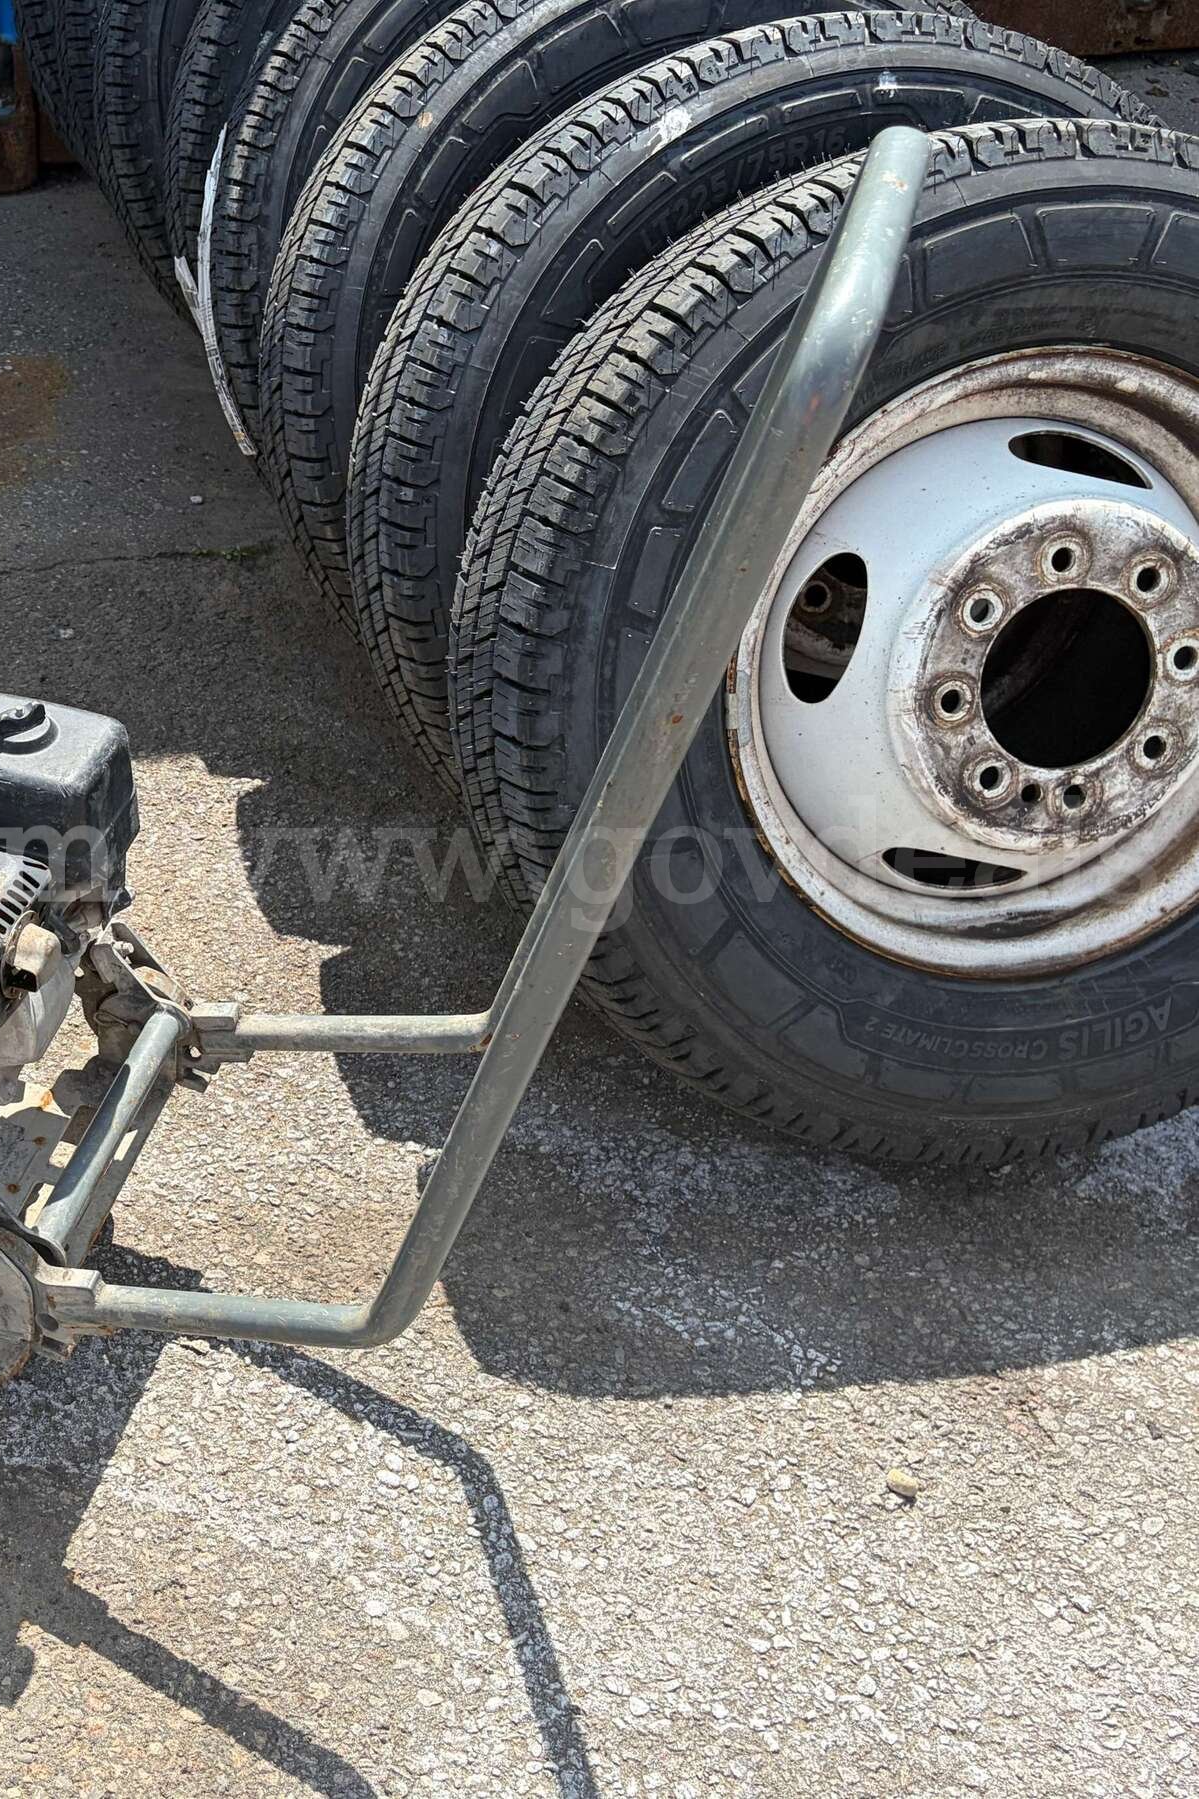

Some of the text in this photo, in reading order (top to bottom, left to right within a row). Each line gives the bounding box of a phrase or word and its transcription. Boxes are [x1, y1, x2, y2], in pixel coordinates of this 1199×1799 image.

[863, 996, 1174, 1061] AGILIS CROSSCLIMATE 2
